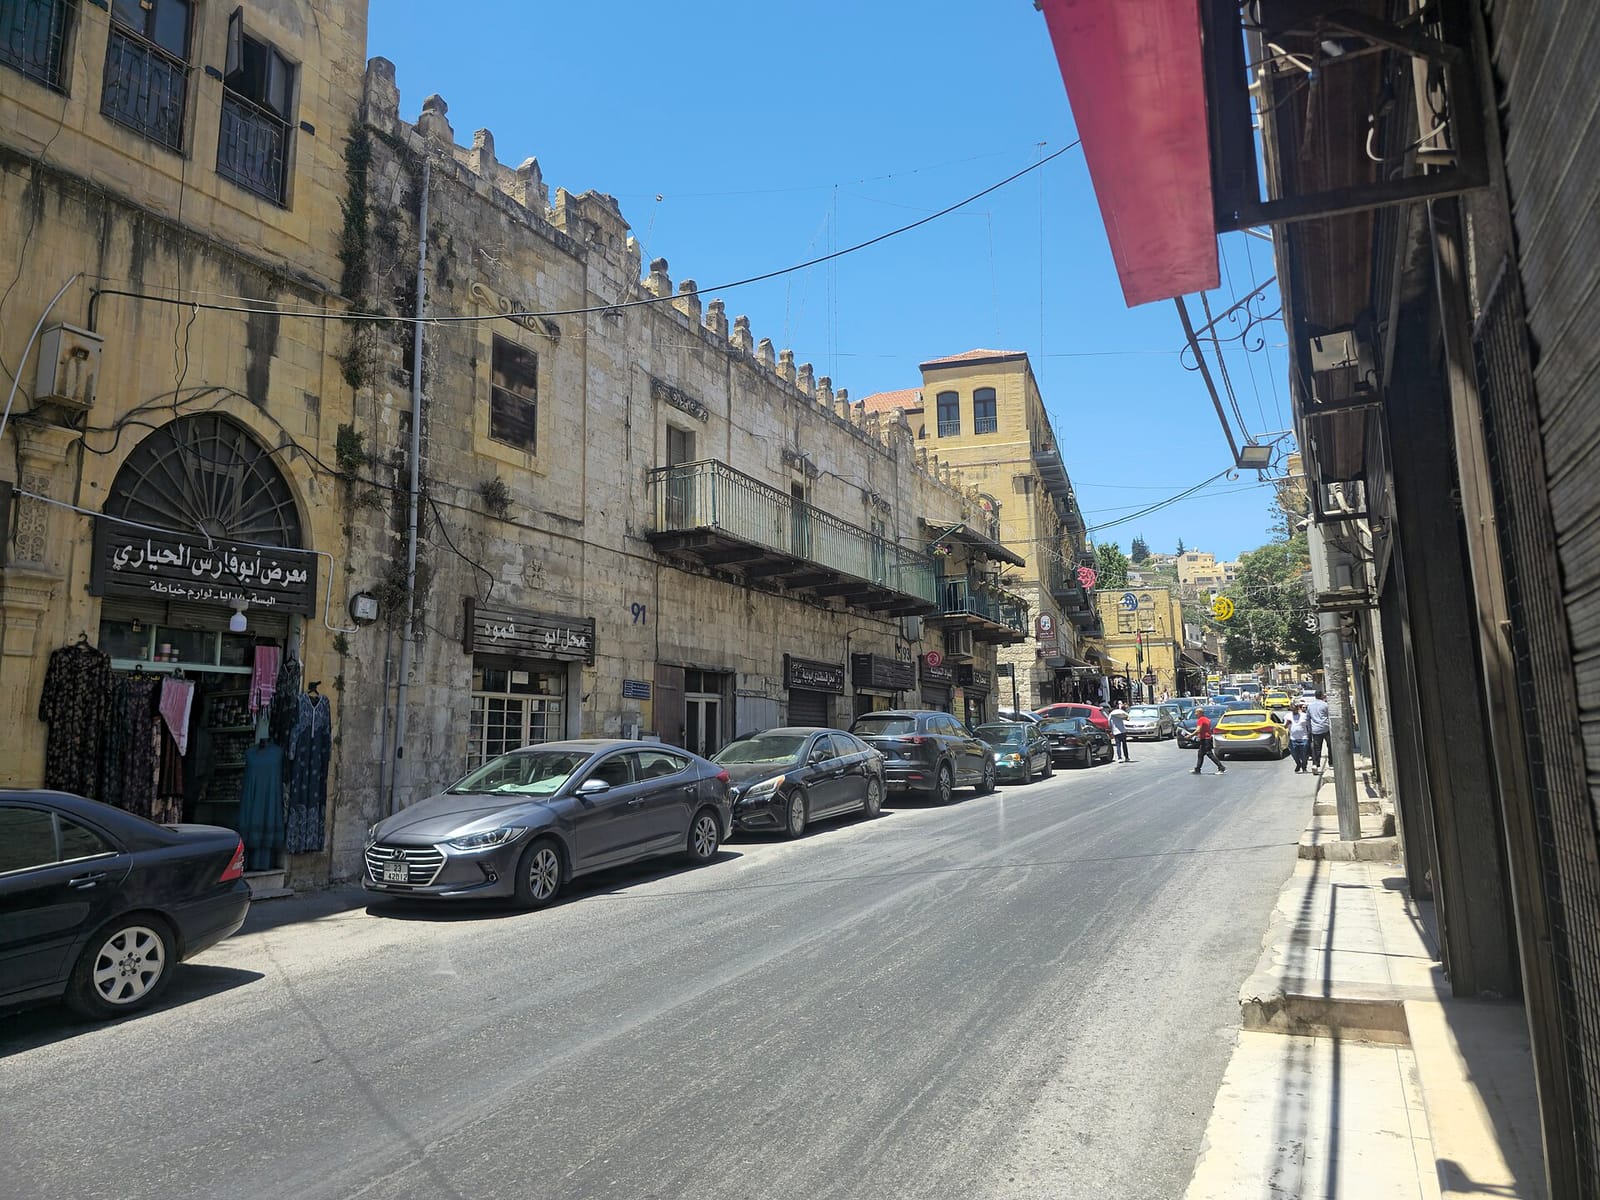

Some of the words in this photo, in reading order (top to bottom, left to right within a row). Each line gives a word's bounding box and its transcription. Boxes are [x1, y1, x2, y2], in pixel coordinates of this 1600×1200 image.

[112, 538, 192, 570] الحياري
[260, 561, 308, 588] معرض
[149, 580, 189, 598] خياطة
[631, 602, 647, 625] 91
[560, 627, 588, 651] محل
